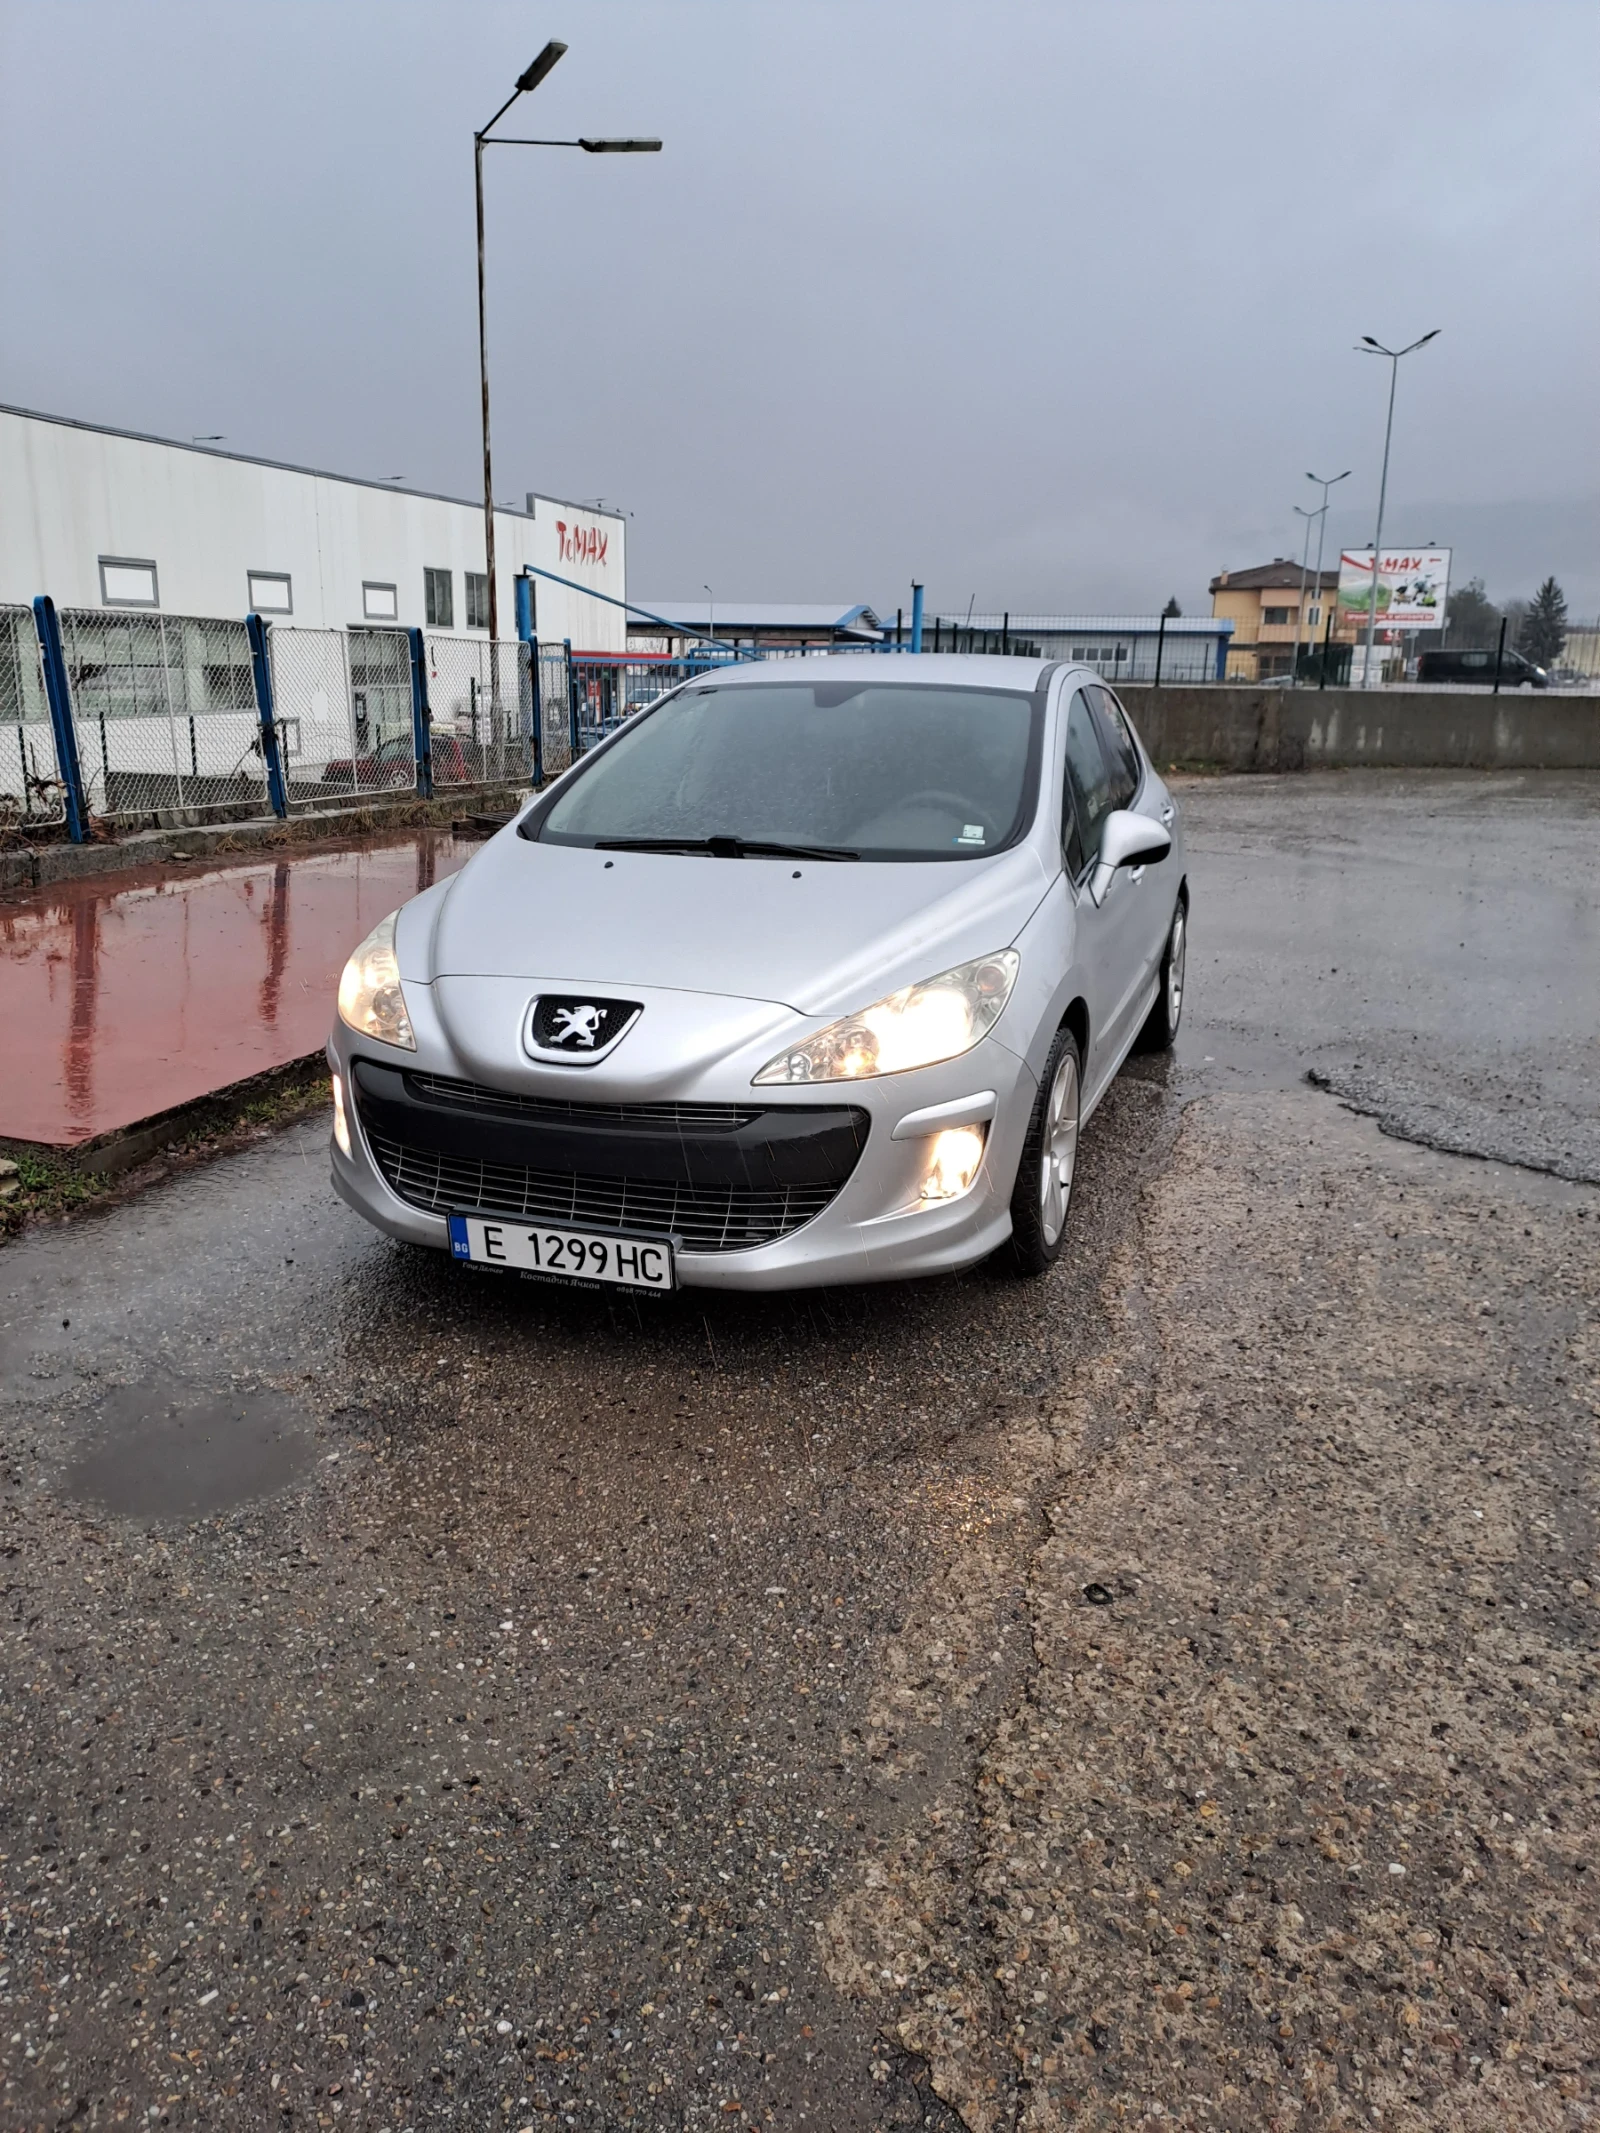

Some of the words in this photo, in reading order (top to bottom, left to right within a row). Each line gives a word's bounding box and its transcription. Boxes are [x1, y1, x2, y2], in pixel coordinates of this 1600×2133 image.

[454, 1241, 469, 1254] BG
[483, 1225, 507, 1260] E
[527, 1232, 608, 1274] 1299
[616, 1243, 663, 1282] HC
[520, 1270, 569, 1285] Костадин
